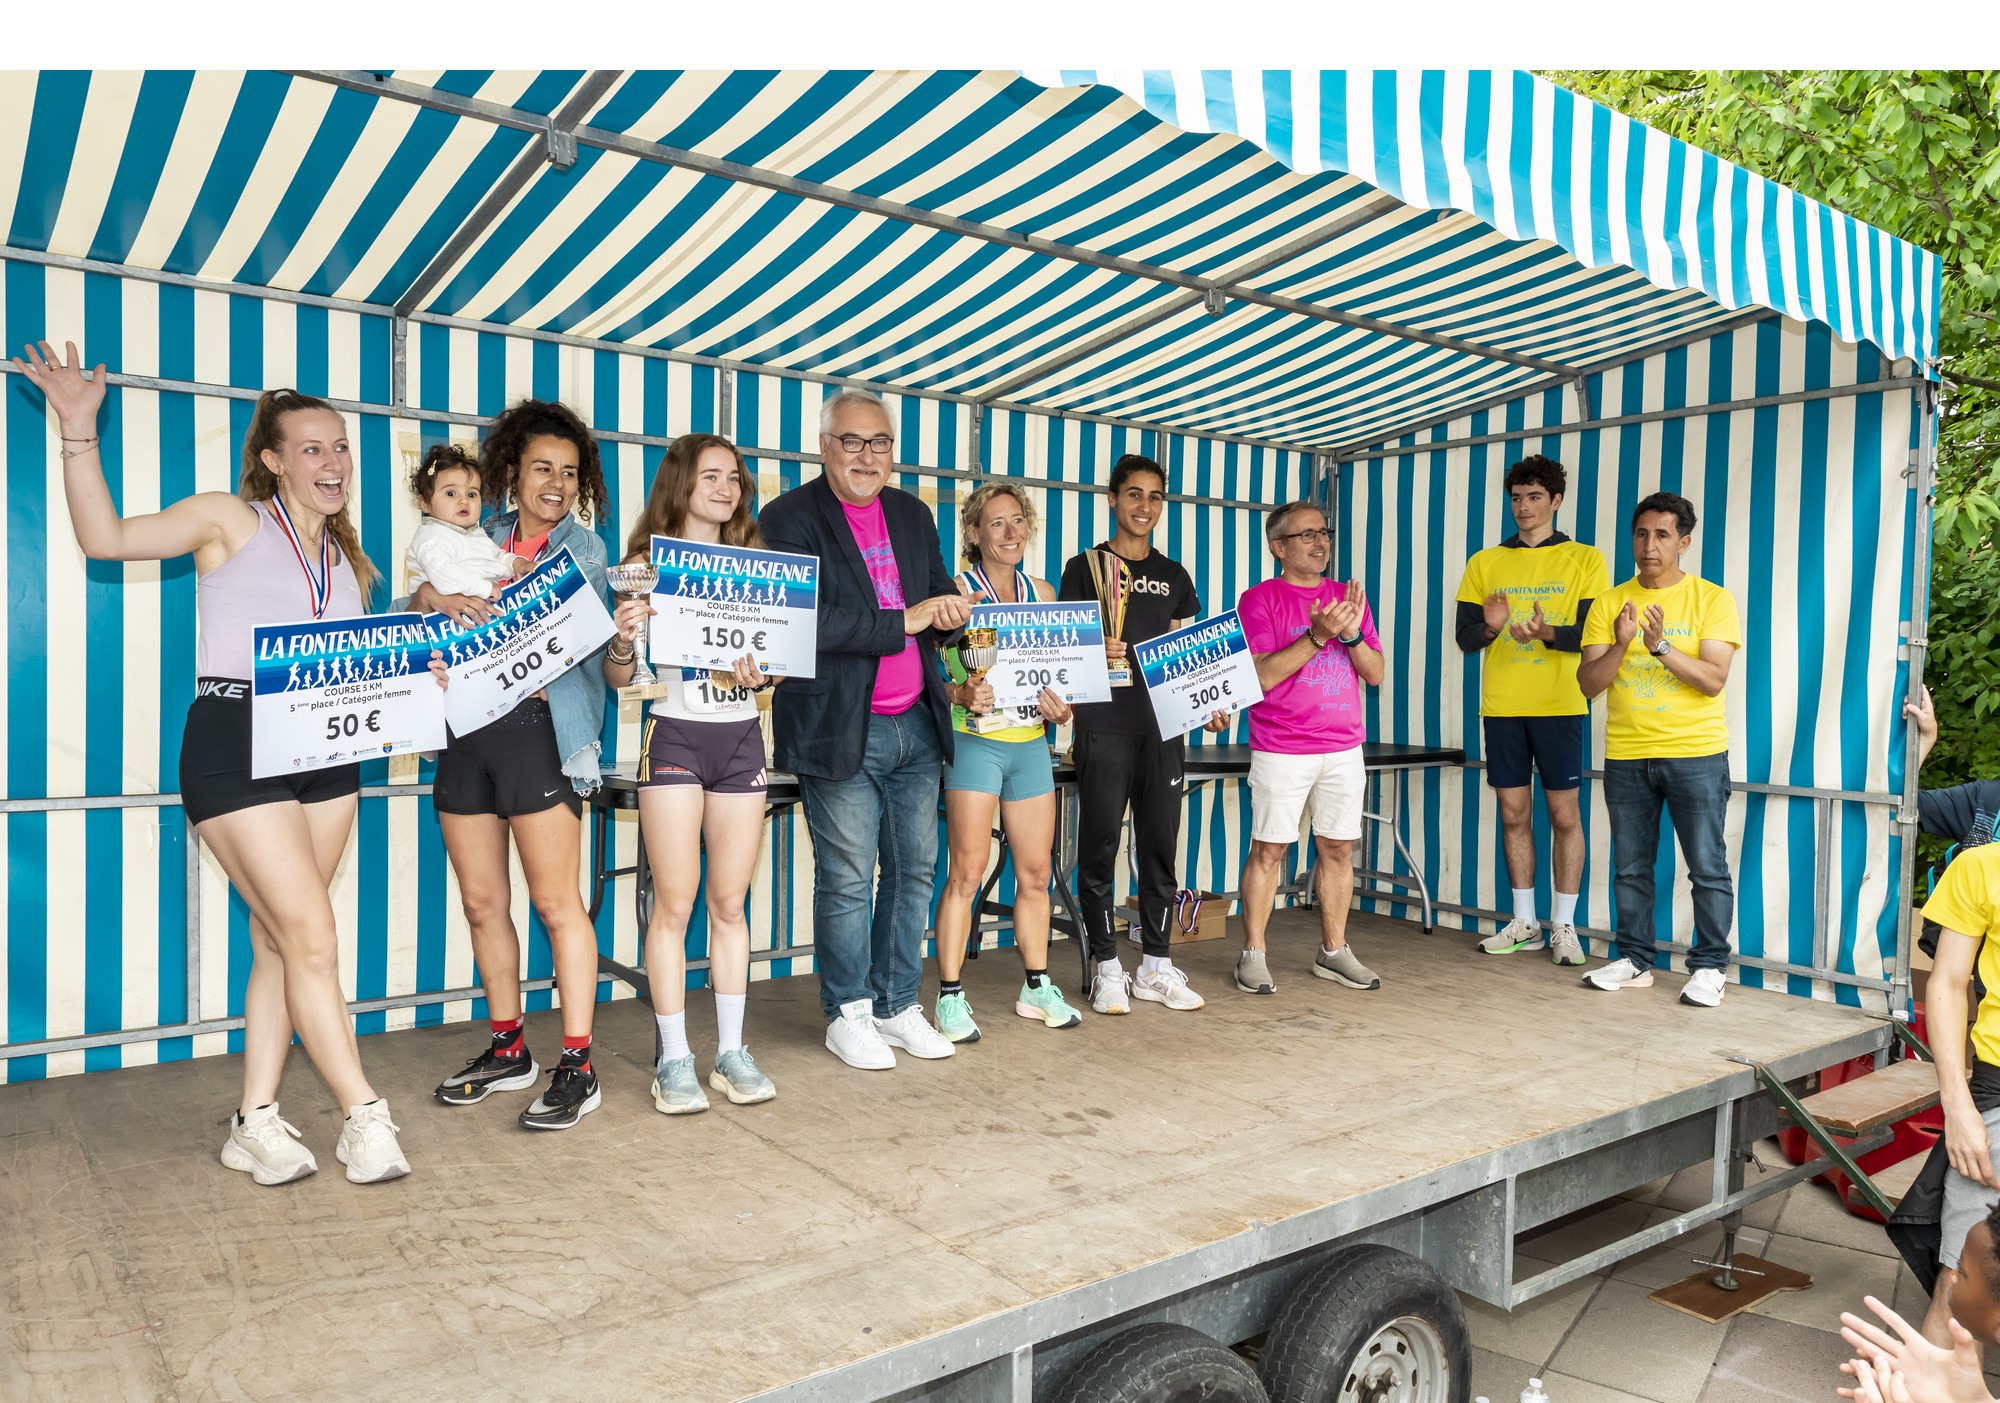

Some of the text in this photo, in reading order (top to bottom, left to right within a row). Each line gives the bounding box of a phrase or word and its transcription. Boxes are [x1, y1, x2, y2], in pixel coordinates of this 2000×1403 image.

[656, 547, 814, 584] LA FONTENAISIENNE
[426, 556, 571, 644] A FONAISIENNE
[1504, 586, 1566, 594] FONTENAISIENNE
[695, 610, 716, 620] place
[722, 612, 761, 624] Catégorie
[762, 616, 789, 626] femme
[707, 601, 740, 612] COURSE
[748, 606, 761, 614] KM
[969, 609, 1097, 629] LA FONTENAISIENNE
[259, 623, 427, 661] LA FONTENAISIENNE
[482, 658, 505, 673] place
[509, 632, 546, 657] Catégorie
[546, 612, 573, 632] femme
[490, 638, 524, 659] COURSE
[529, 623, 543, 634] KM
[701, 626, 767, 651] 150 €
[1142, 617, 1239, 667] LA FONTENAISIENNE
[496, 651, 543, 690] 100
[546, 636, 564, 655] €
[1008, 657, 1026, 665] place
[1031, 656, 1061, 665] Catégorie
[1187, 668, 1209, 680] COURSE
[1213, 663, 1221, 671] KM
[324, 682, 383, 697] COURSE 5 KM
[1015, 668, 1069, 687] 200 €
[1182, 682, 1195, 691] place
[1199, 671, 1222, 684] Catégorie
[1222, 664, 1237, 675] femme
[290, 704, 295, 712] 5
[310, 699, 335, 712] place
[342, 691, 382, 706] Catégorie
[384, 689, 412, 699] femme
[698, 682, 748, 704] 1038
[1189, 685, 1219, 709] 300
[1222, 679, 1232, 696] €
[326, 709, 381, 740] 50 €
